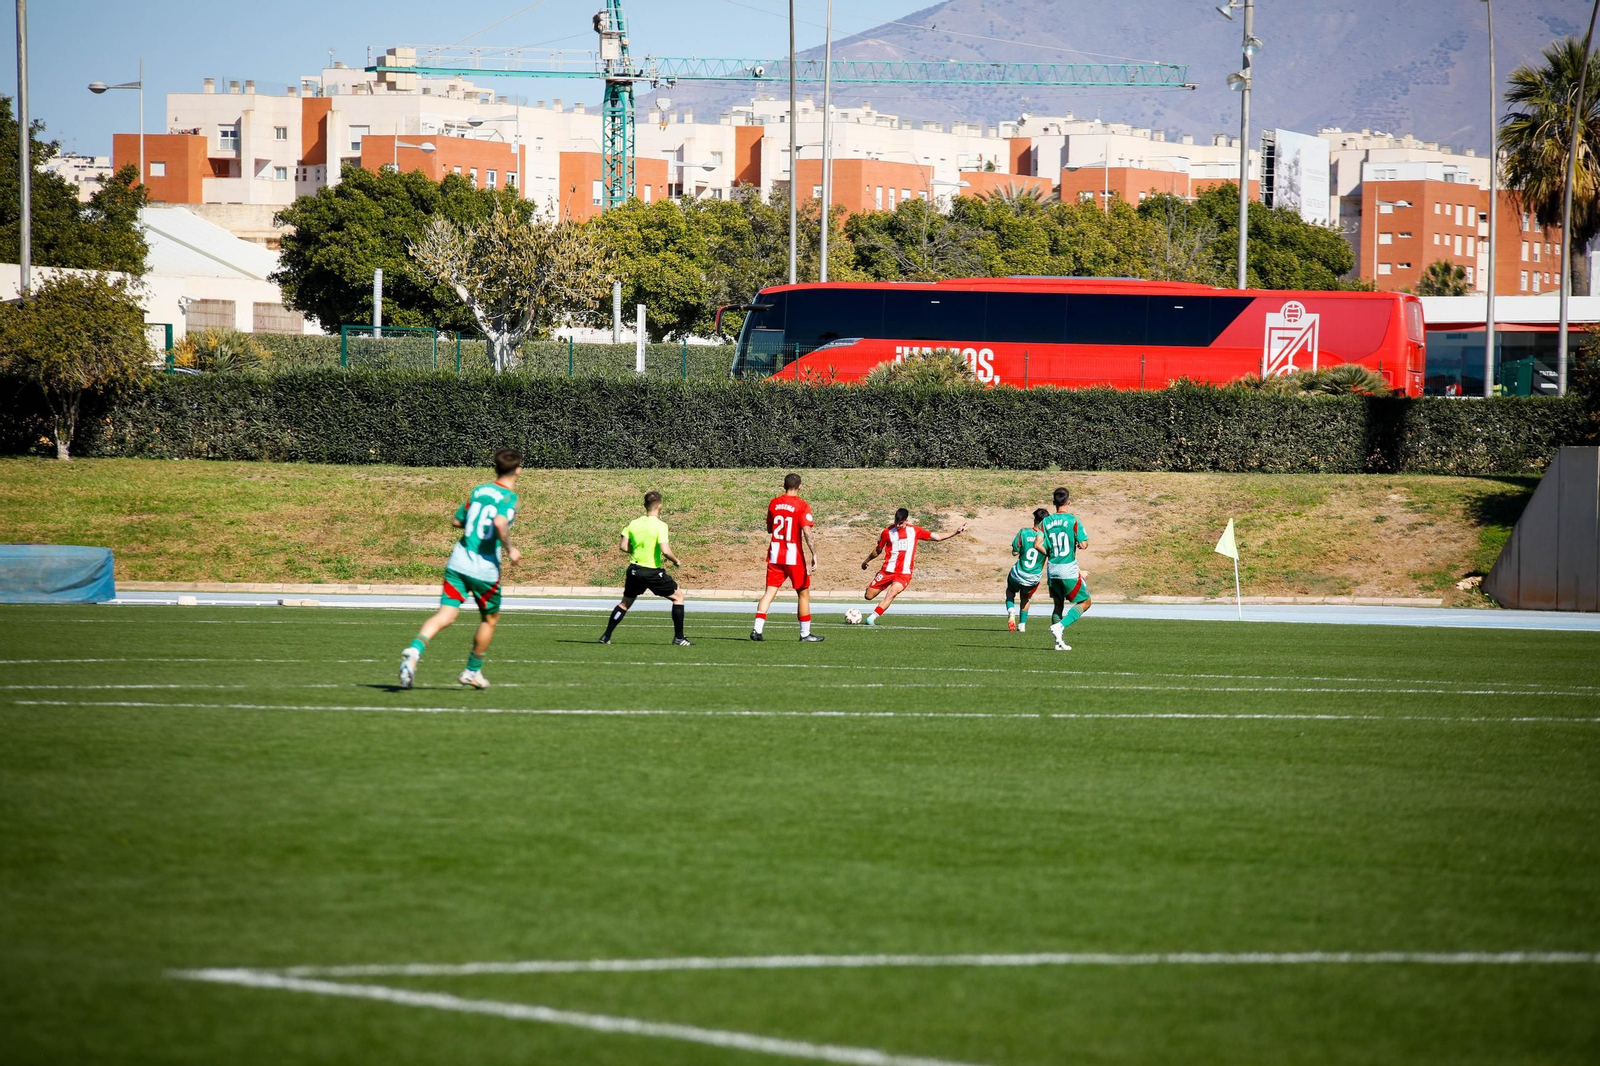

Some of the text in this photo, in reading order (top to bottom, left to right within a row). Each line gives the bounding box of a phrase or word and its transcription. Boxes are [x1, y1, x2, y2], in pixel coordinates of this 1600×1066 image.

[896, 346, 1000, 385] ¡OS,
[465, 501, 498, 540] 16
[773, 515, 793, 541] 21
[1049, 531, 1070, 557] 10
[1024, 547, 1039, 569] 9
